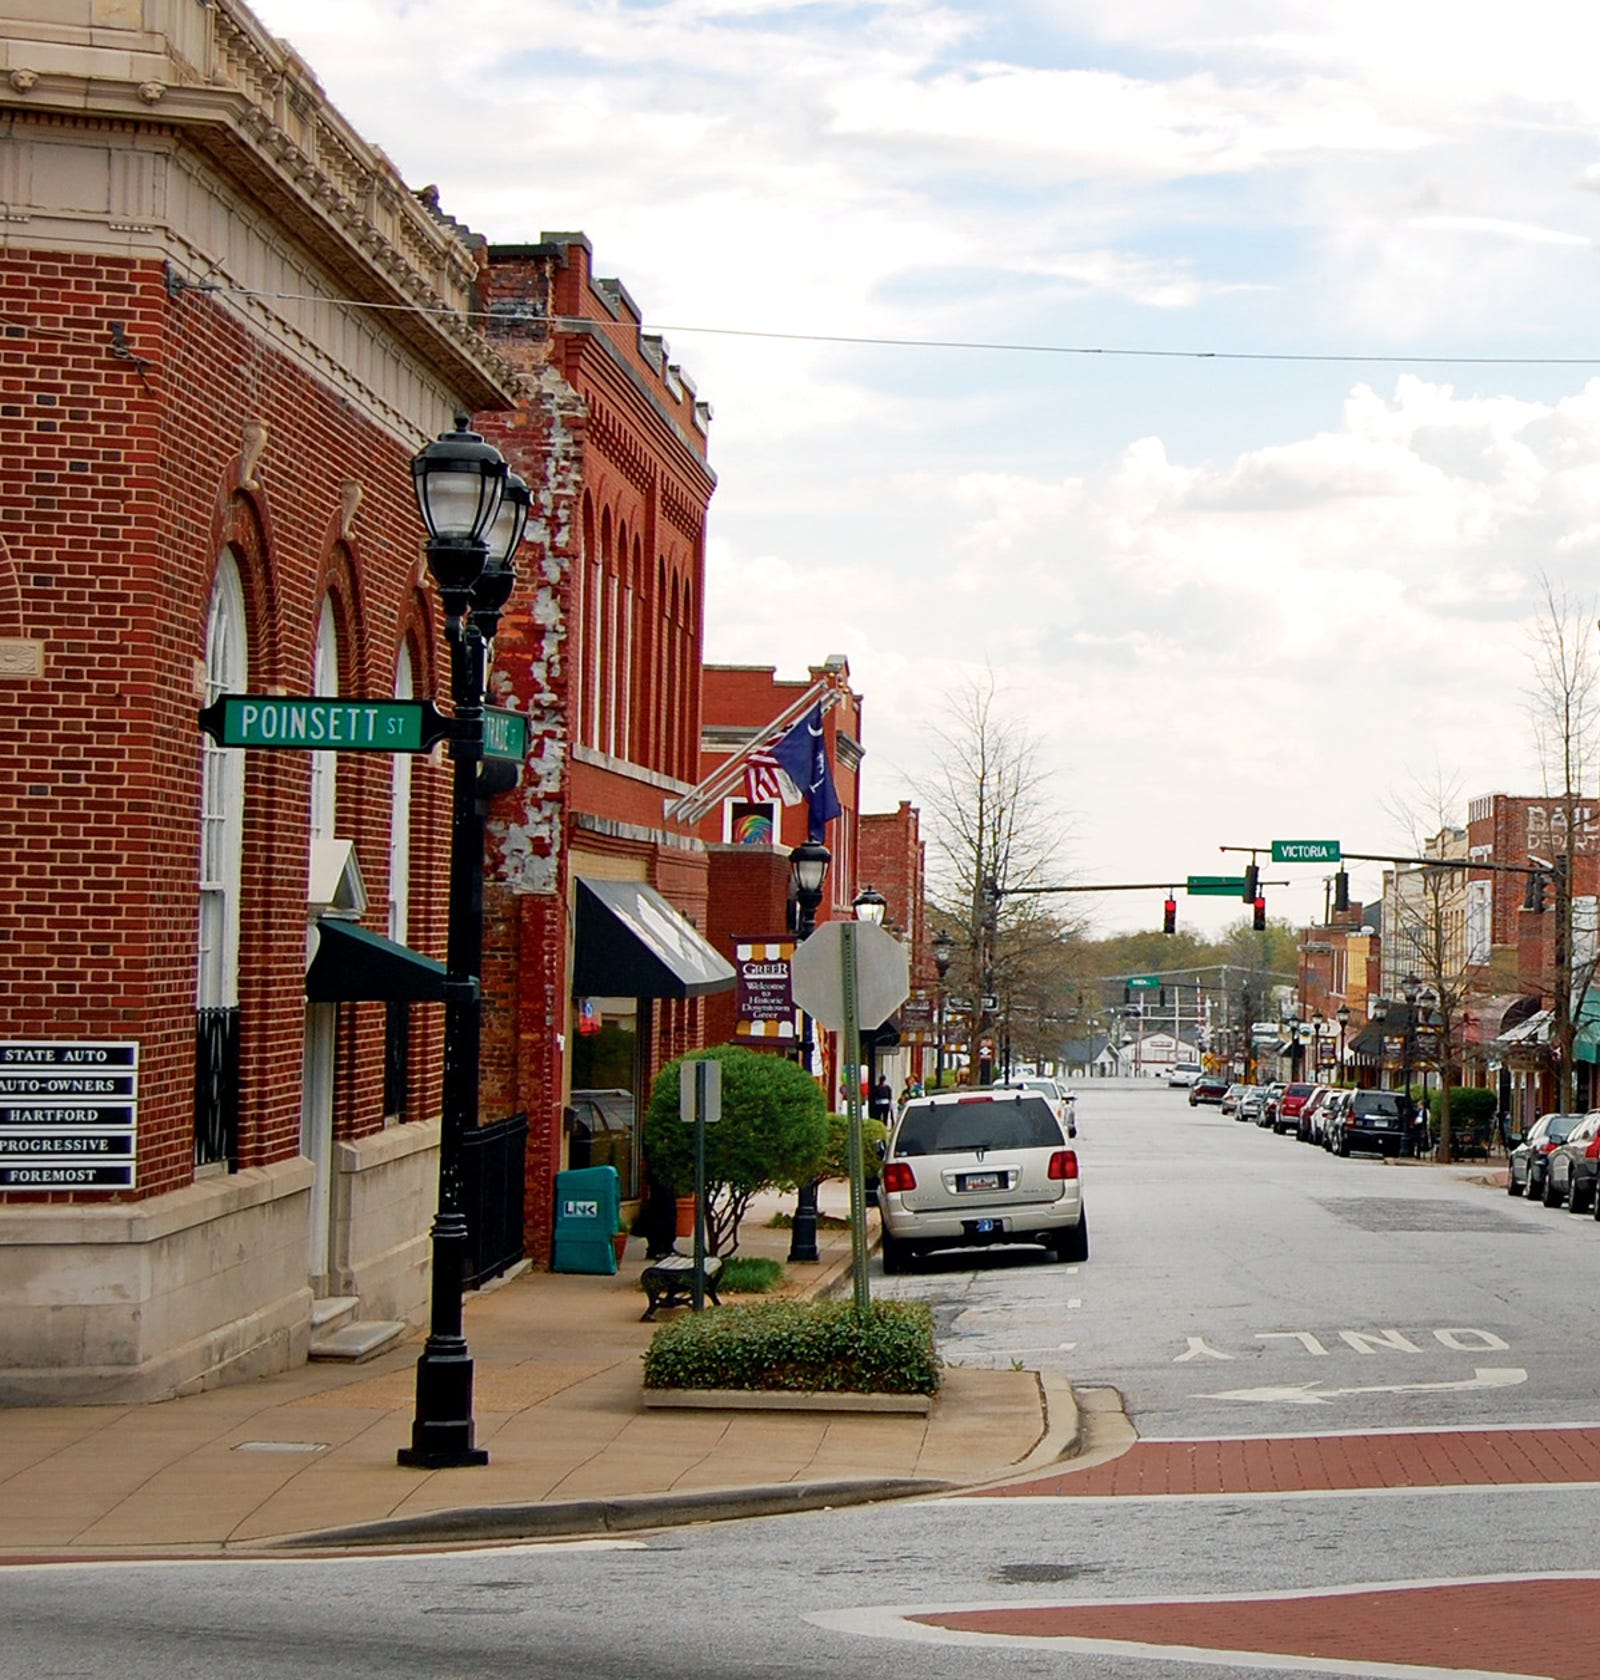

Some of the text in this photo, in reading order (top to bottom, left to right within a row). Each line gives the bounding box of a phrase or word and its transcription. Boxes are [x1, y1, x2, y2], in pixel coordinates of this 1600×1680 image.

[241, 705, 405, 741] POINSETT ST
[1281, 845, 1328, 858] VICTORIA
[742, 962, 788, 975] GREER
[746, 981, 786, 990] Welcome
[5, 1049, 108, 1062] STATE AUTO
[0, 1079, 115, 1092] AUTO-OWNERS
[10, 1109, 99, 1122] HARTFORD
[0, 1139, 110, 1151] PROGRESSIVE
[10, 1169, 97, 1182] FOREMOST
[1173, 1327, 1511, 1362] ONLY
